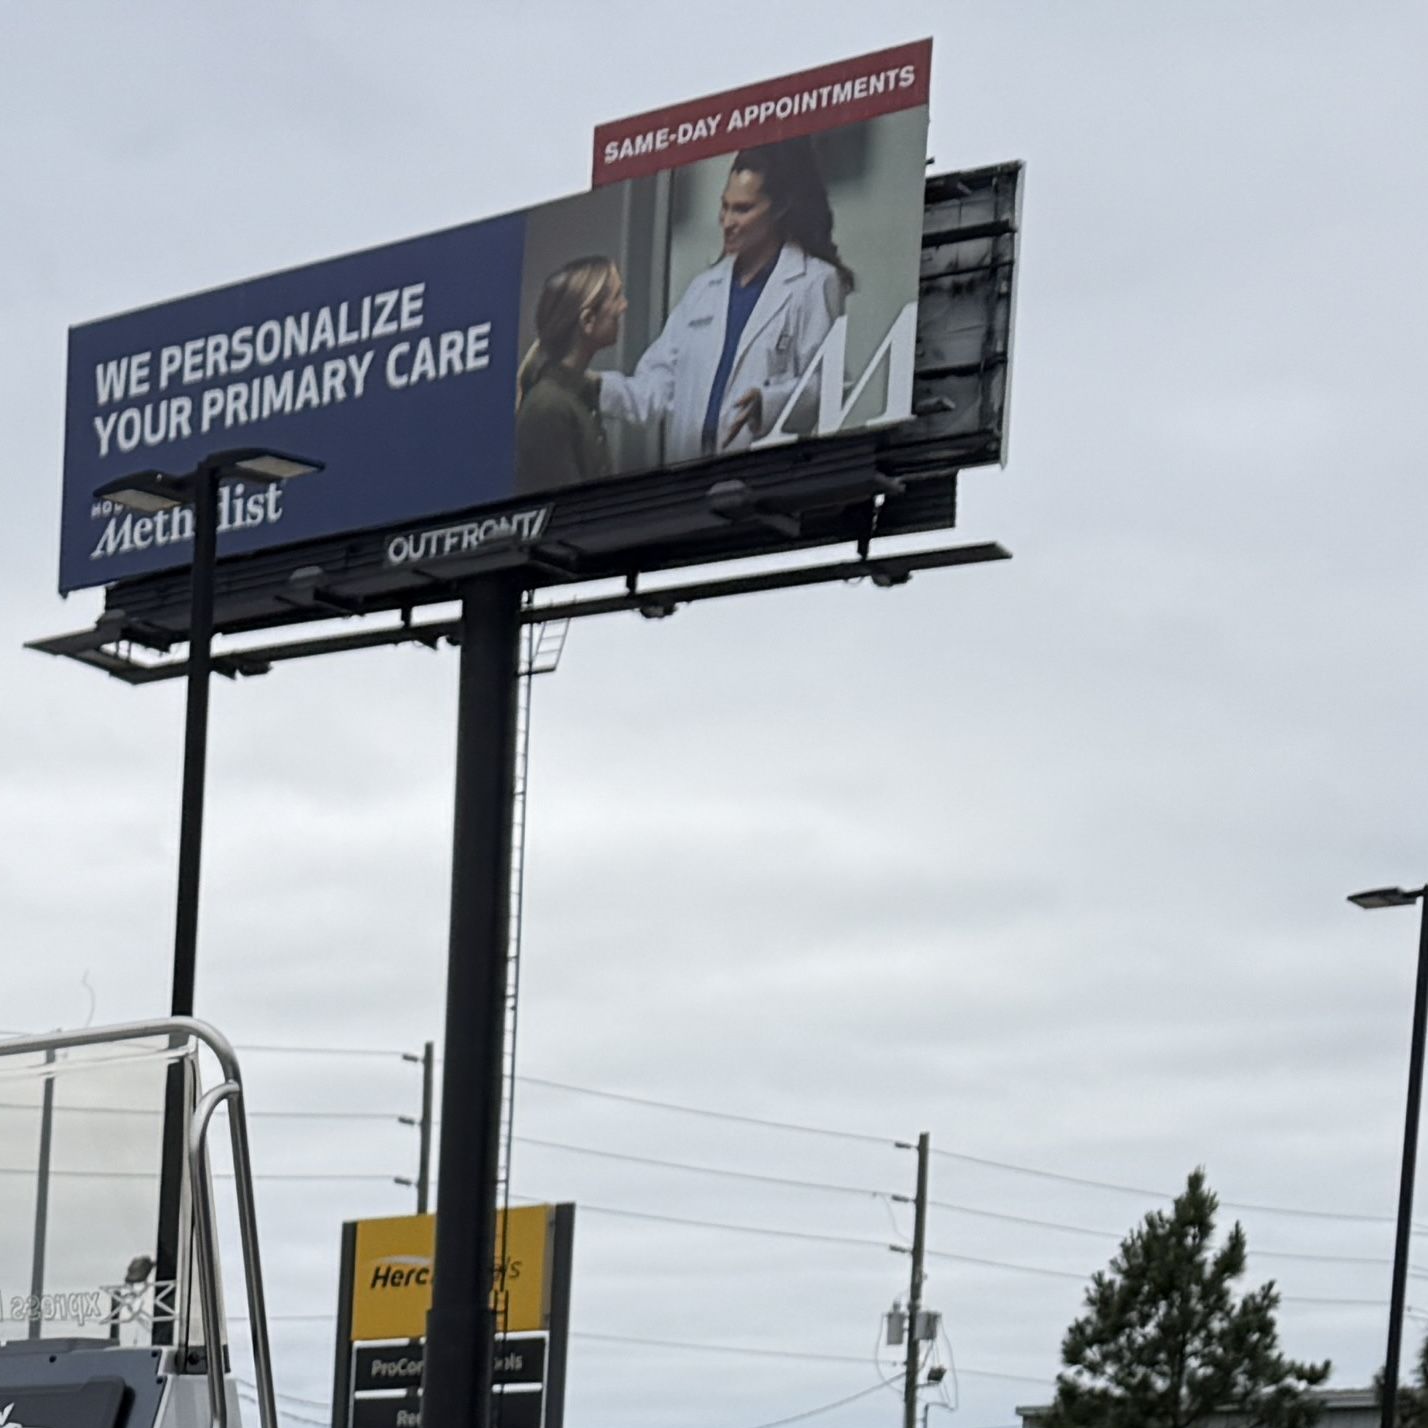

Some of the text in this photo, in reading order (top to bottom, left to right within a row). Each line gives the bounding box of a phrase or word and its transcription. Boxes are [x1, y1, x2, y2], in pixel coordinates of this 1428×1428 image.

[604, 64, 917, 165] SAME-DAY APPOINTMENTS
[93, 321, 492, 458] YOUR PRIMARY CARE
[95, 281, 426, 406] WE PERSONALIZE
[370, 1264, 430, 1290] Herc
